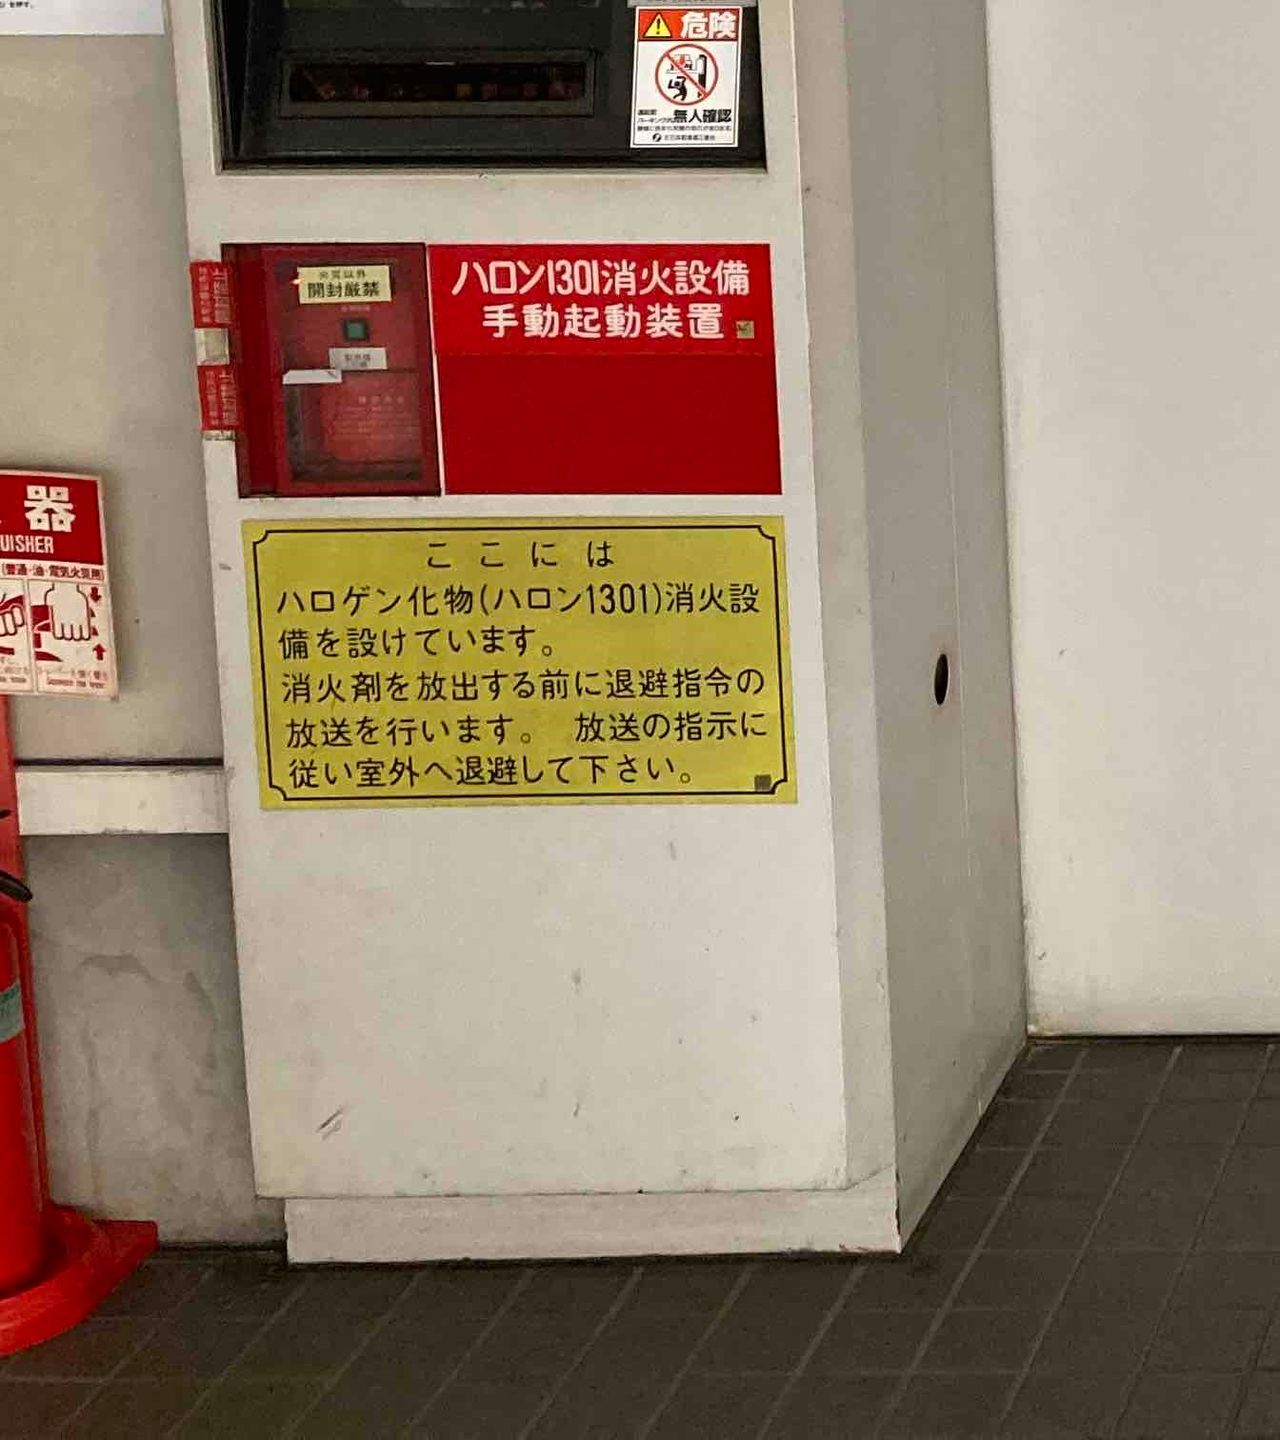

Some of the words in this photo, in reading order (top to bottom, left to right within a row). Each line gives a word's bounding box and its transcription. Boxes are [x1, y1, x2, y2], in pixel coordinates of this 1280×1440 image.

[680, 11, 737, 39] 危険
[673, 109, 732, 123] 無人確認
[307, 282, 380, 299] 開封厳禁
[452, 259, 750, 296] ハロン1301消火設備
[482, 303, 724, 339] 手動起動装置
[427, 541, 615, 568] ここには
[277, 583, 760, 618] ハロゲン化物(ハロン1301)消火設
[278, 625, 553, 660] 備を設けています。
[282, 667, 765, 705] 消火剤を放出する前に退避指令の
[288, 755, 692, 789] 従い室外へ退避して下さい。
